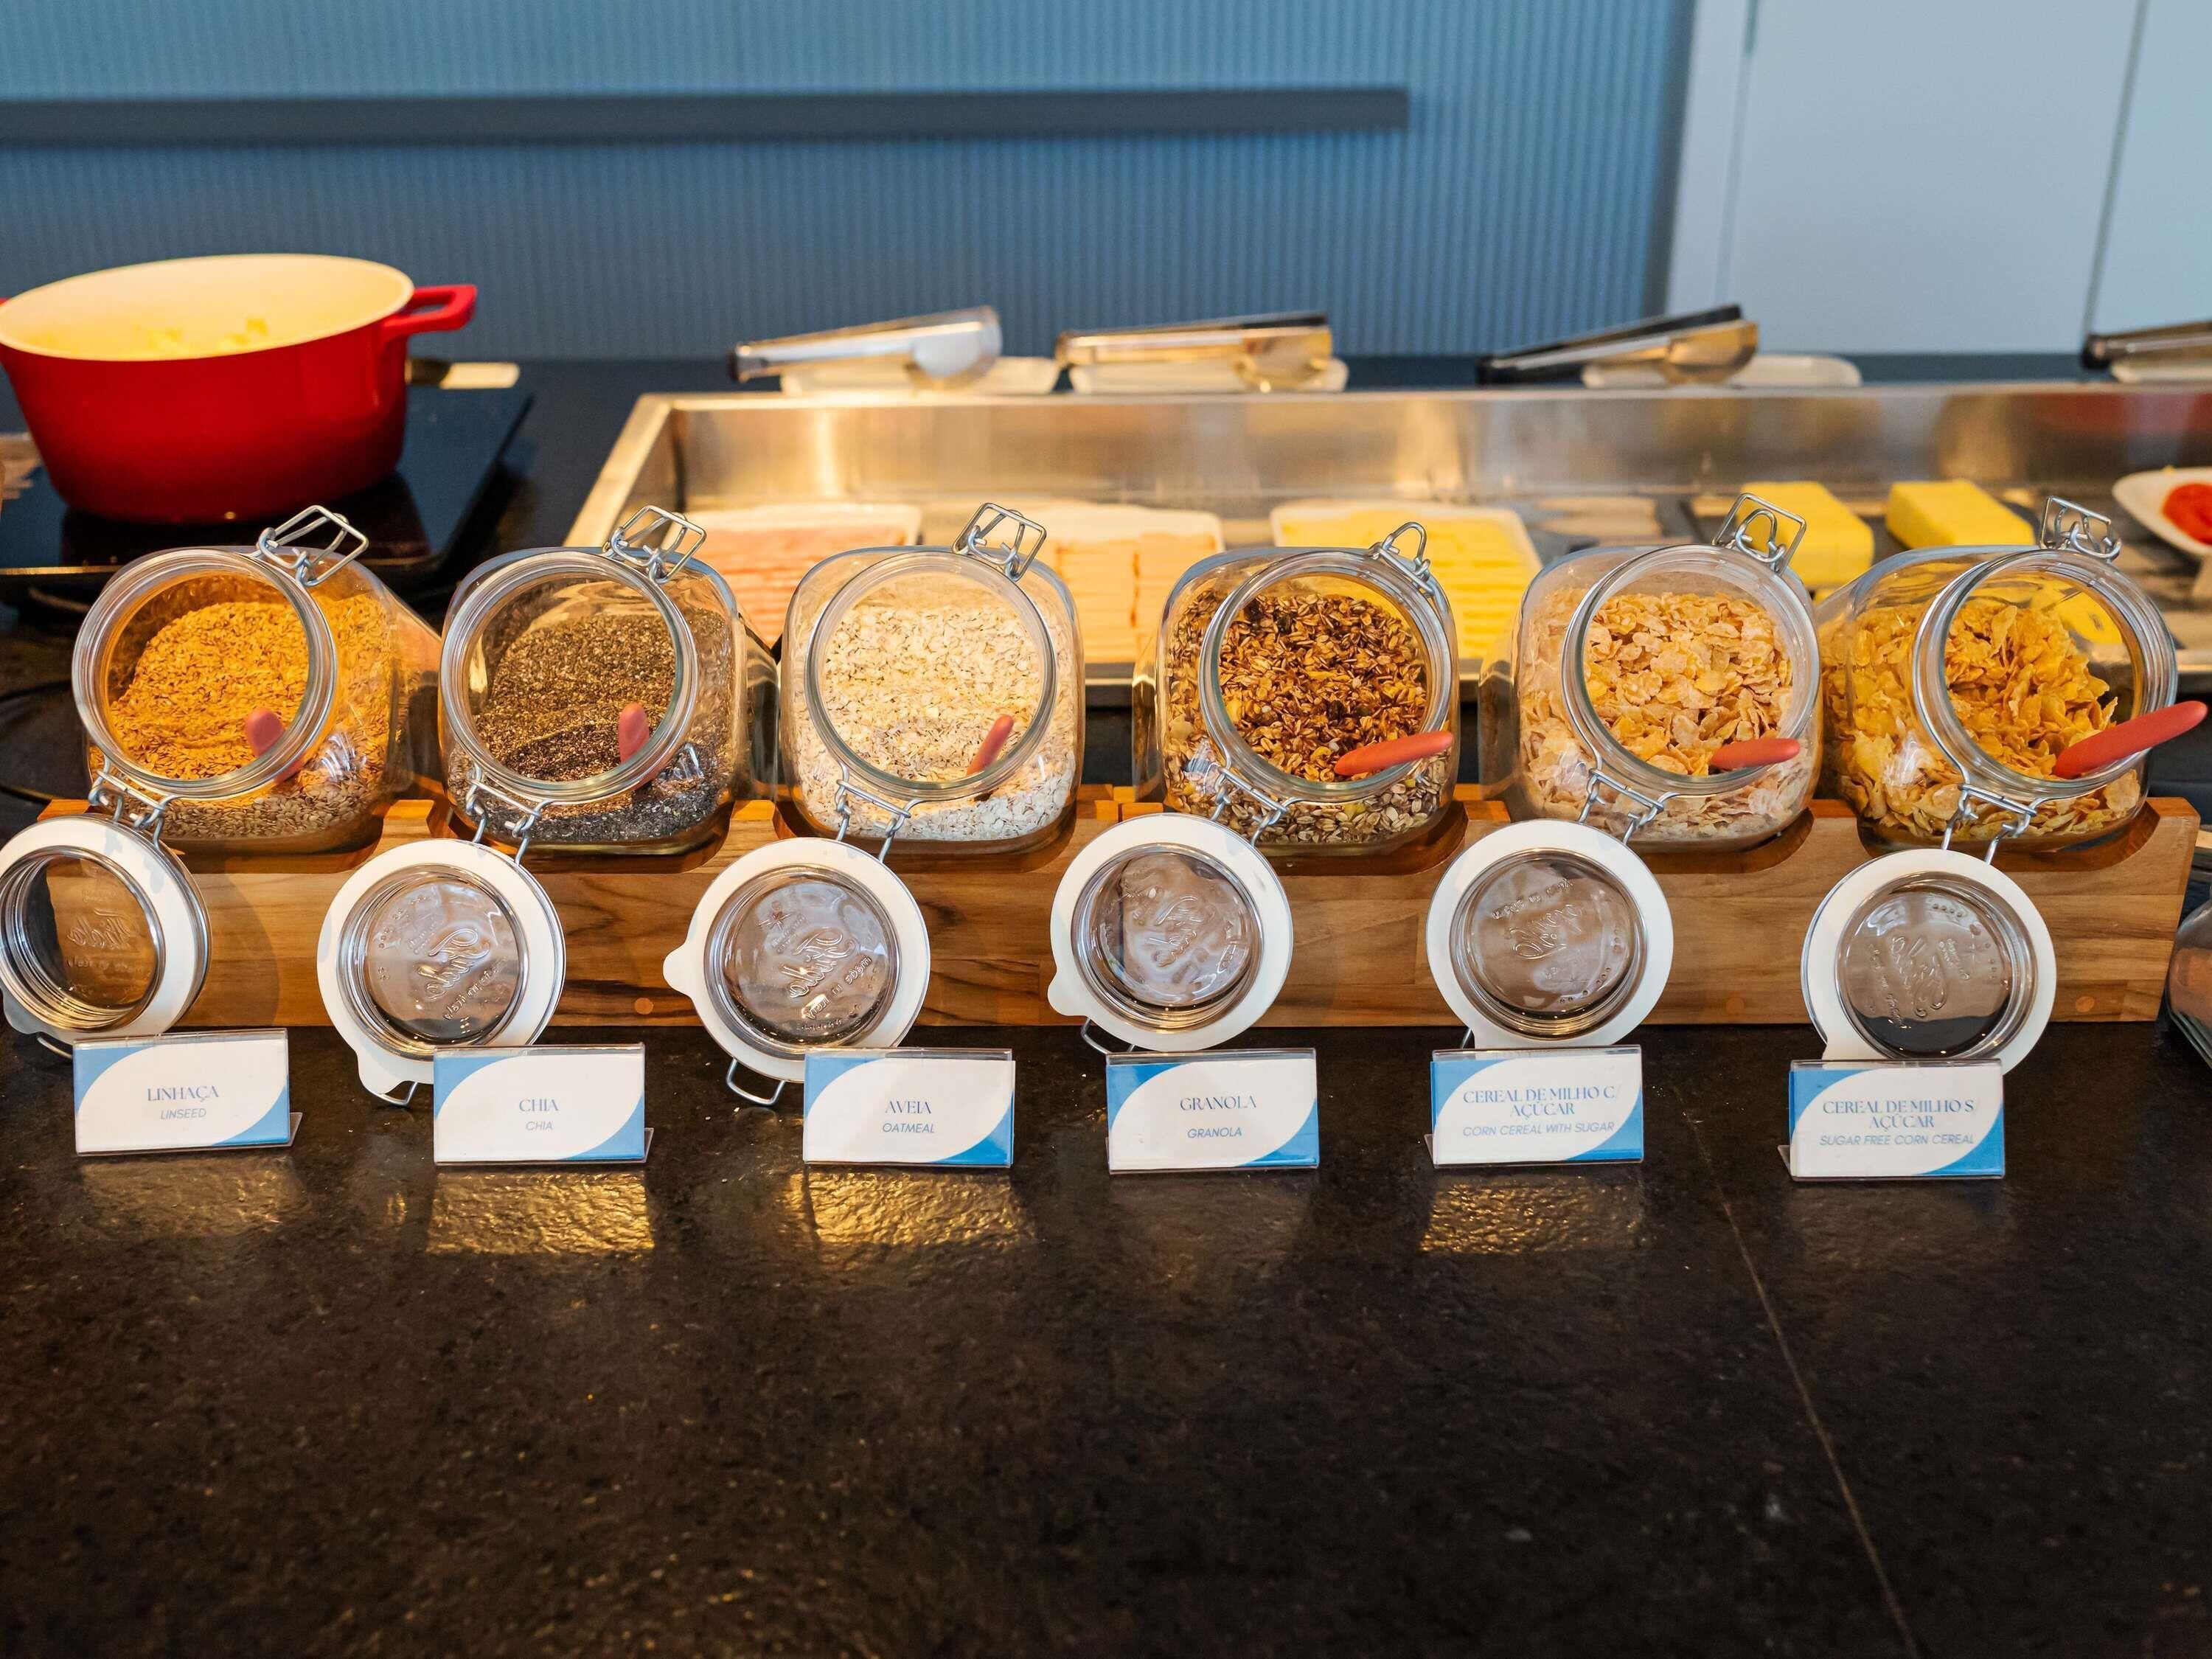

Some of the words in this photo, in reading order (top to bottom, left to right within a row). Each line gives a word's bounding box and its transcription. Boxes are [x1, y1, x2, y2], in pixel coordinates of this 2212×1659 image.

[147, 1085, 219, 1103] LINHAÇA
[1463, 1089, 1523, 1103] CEREAL
[1526, 1088, 1546, 1101] DE
[1548, 1087, 1599, 1100] MILHO
[518, 1099, 559, 1112] CHIA
[885, 1101, 932, 1115] AVEIA
[1180, 1096, 1257, 1111] GRANOLA
[1510, 1101, 1575, 1119] AÇÚCAR
[1823, 1100, 1883, 1114] CEREAL
[1886, 1100, 1907, 1113] DE
[1910, 1099, 1961, 1113] MILHO
[160, 1108, 206, 1120] LINSEED
[525, 1121, 554, 1131] CHIA
[882, 1122, 935, 1133] OATMEAL
[1463, 1125, 1496, 1137] CORN
[1500, 1124, 1543, 1135] CEREAL
[1545, 1123, 1571, 1134] WITH
[1575, 1121, 1615, 1133] SUGAR
[1869, 1113, 1935, 1131] AÇÚCAR
[1187, 1127, 1242, 1138] GRANOLA
[1819, 1135, 1860, 1146] SUGAR
[1863, 1135, 1890, 1145] FREE
[1893, 1135, 1929, 1145] CORN
[1933, 1133, 1974, 1144] CEREAL
